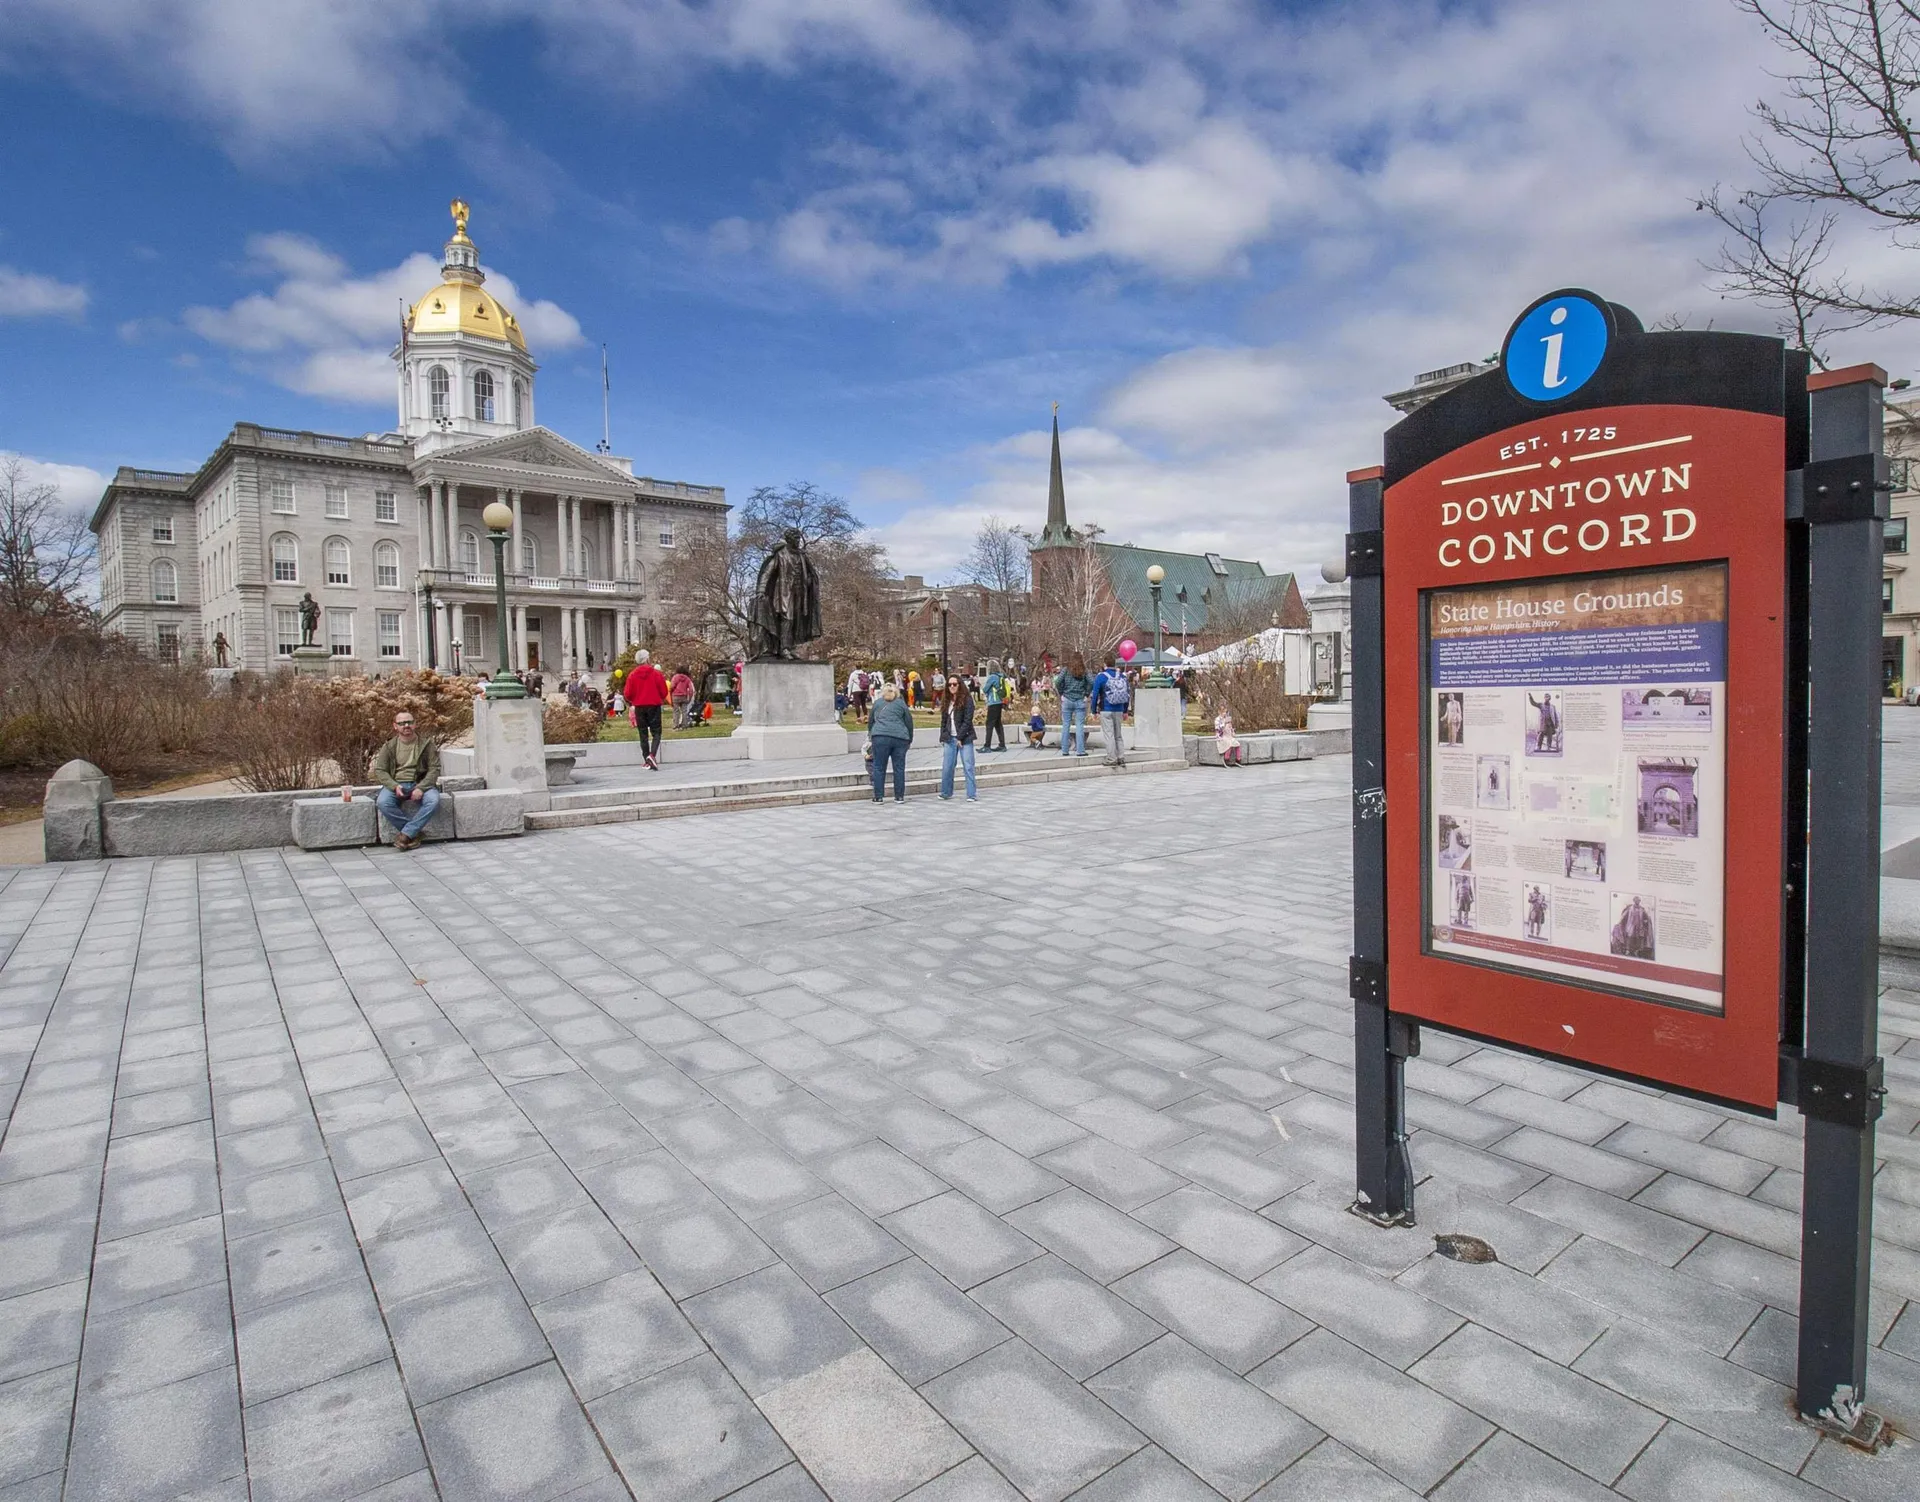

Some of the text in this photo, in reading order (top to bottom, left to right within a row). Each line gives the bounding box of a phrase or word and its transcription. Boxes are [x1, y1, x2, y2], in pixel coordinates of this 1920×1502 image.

[1500, 426, 1617, 461] EST. 1725
[1441, 463, 1693, 526] DOWNTOWN
[1438, 508, 1697, 568] CONCORD
[1440, 584, 1684, 624] State House Grounds
[1440, 626, 1472, 634] Honoring
[1473, 624, 1489, 632] New
[1531, 619, 1560, 628] History
